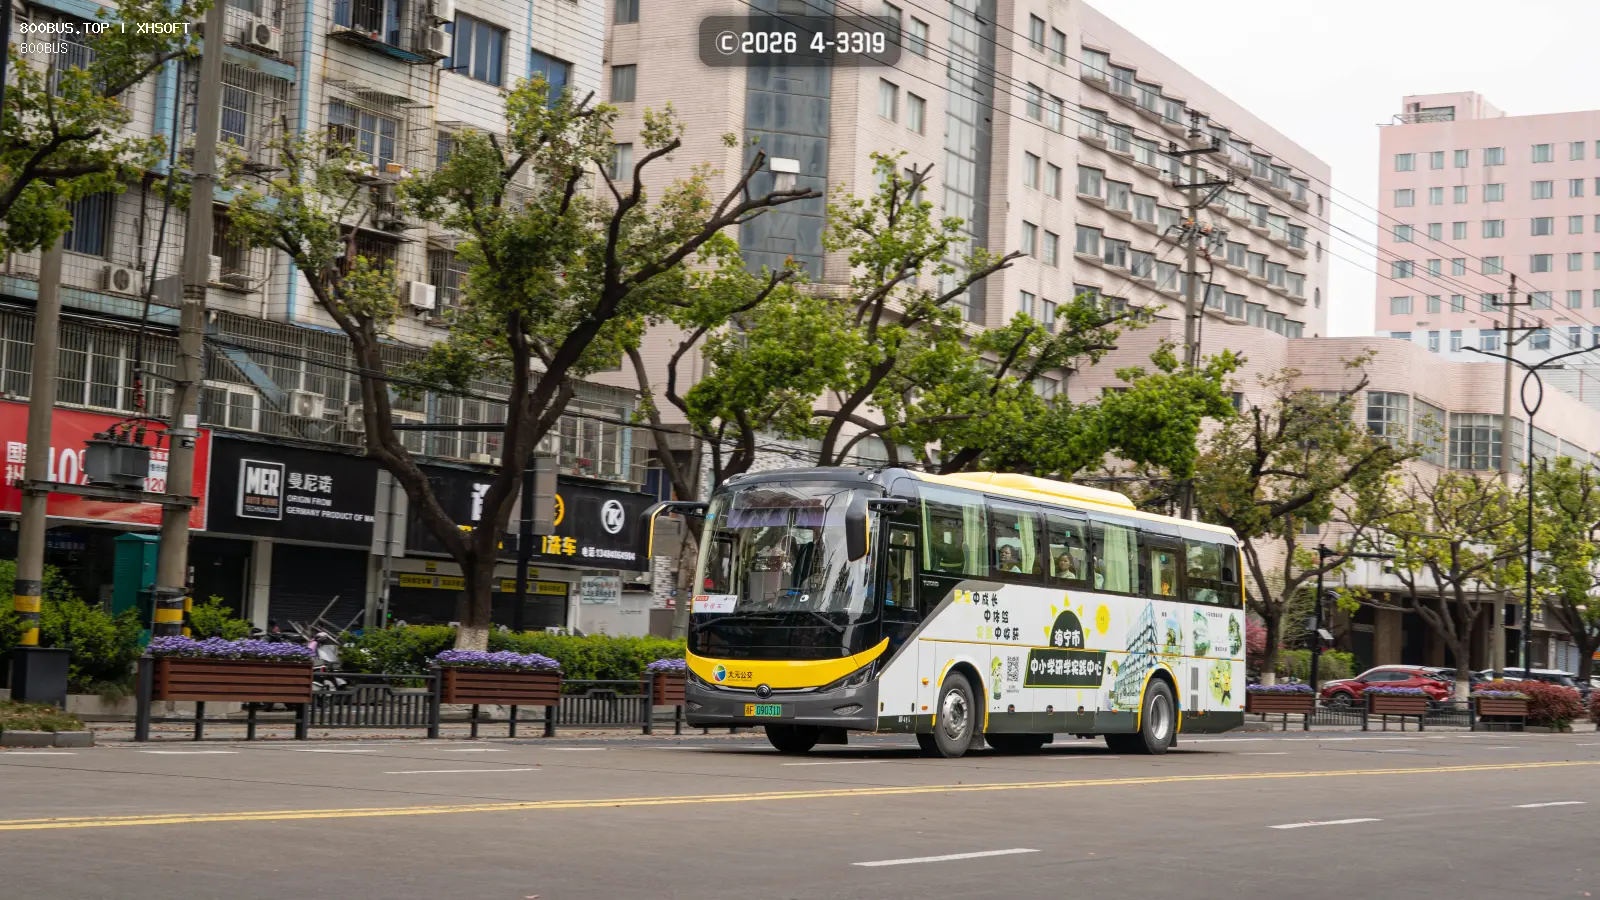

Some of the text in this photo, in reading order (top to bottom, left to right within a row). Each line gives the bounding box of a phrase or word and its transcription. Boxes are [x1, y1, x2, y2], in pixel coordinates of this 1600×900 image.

[246, 466, 280, 497] MER
[286, 494, 333, 507] ORIGIN FROM
[285, 506, 320, 517] GERMANY
[321, 509, 354, 520] PRODUCT
[354, 513, 364, 522] OF
[541, 535, 577, 556] 洗车
[1055, 629, 1081, 647] 海宁市
[727, 670, 753, 680] 大元公交
[1030, 657, 1102, 677] 中小学研学实践中心
